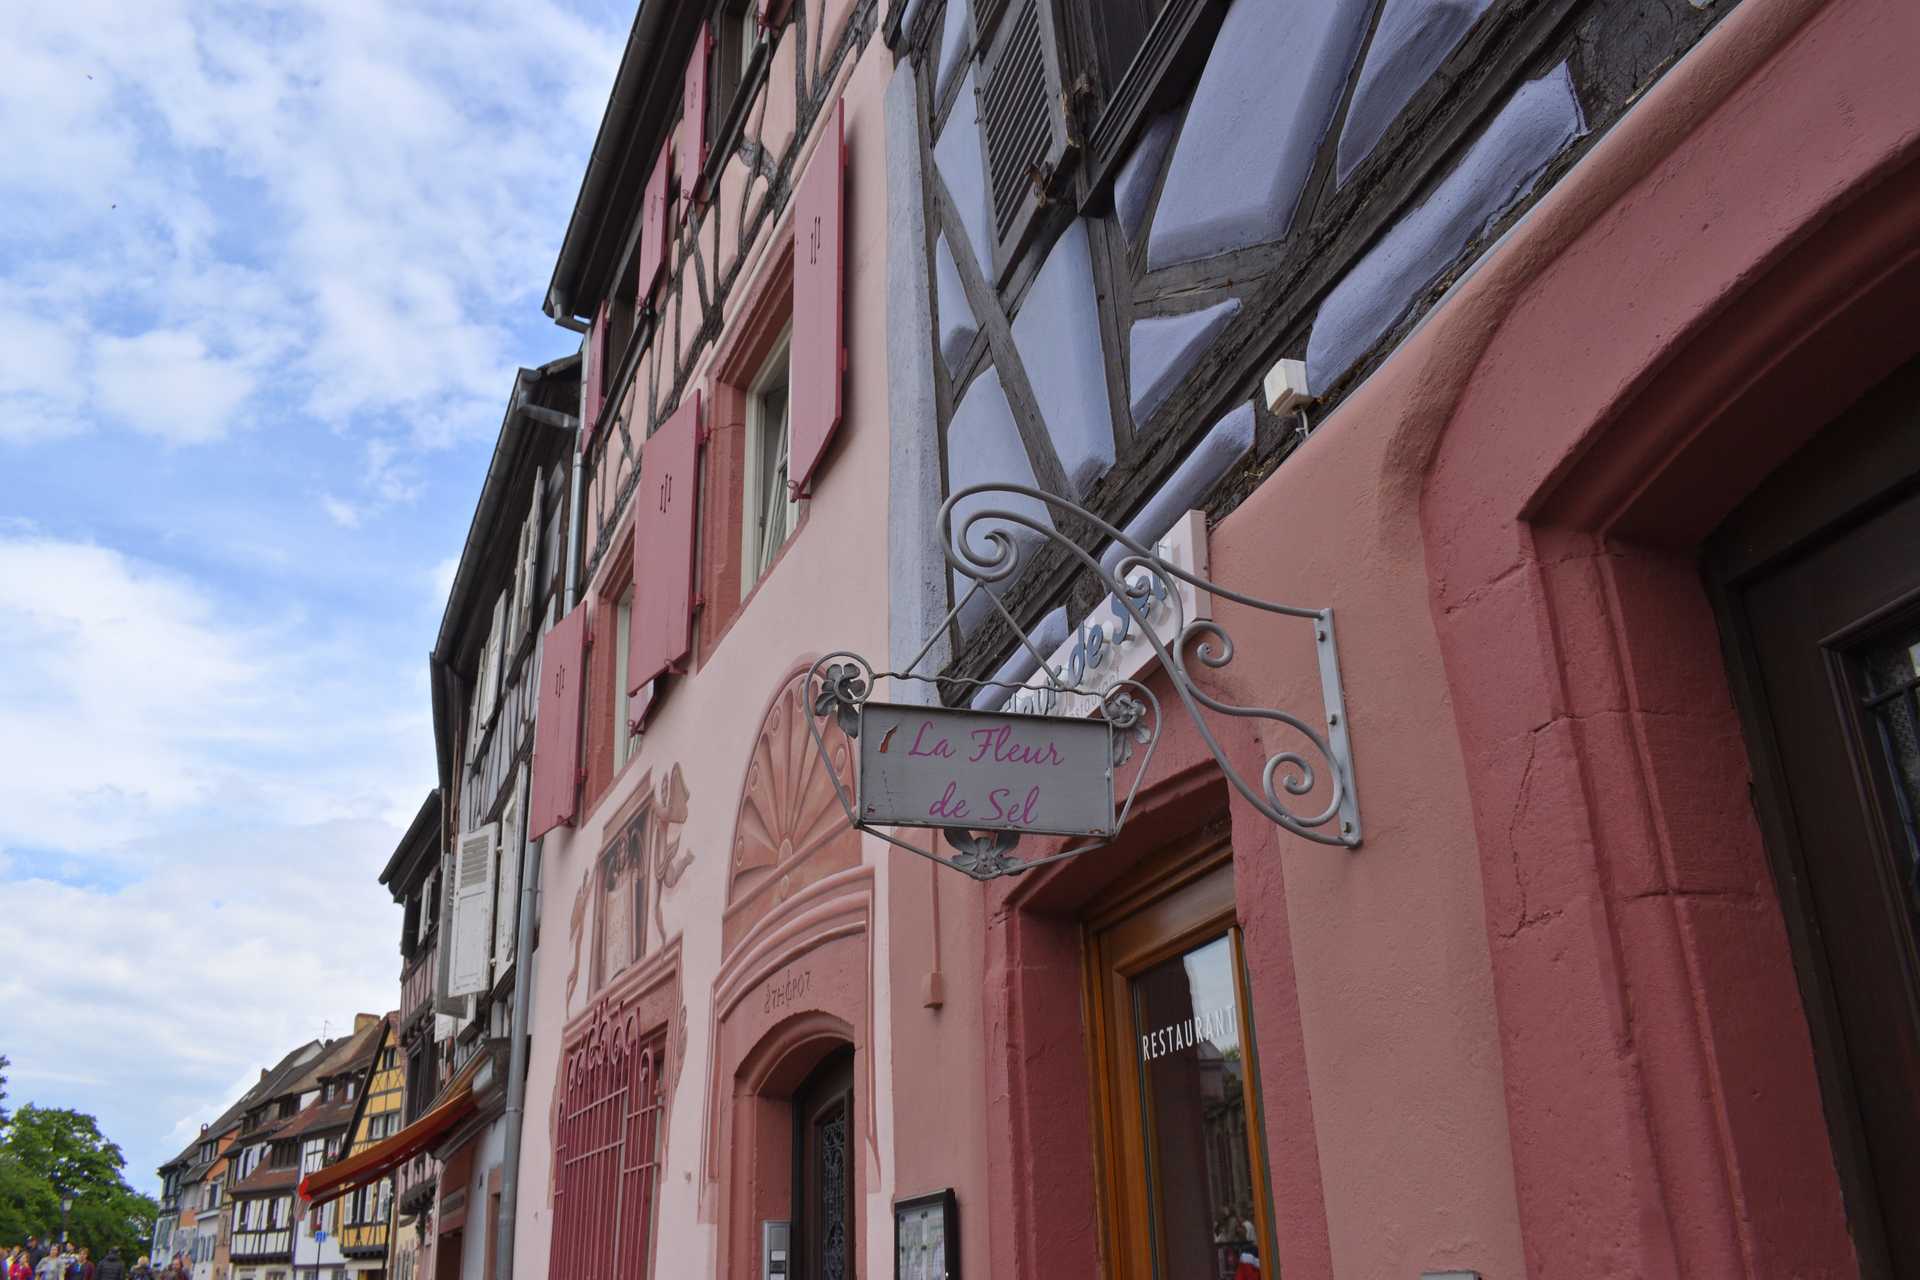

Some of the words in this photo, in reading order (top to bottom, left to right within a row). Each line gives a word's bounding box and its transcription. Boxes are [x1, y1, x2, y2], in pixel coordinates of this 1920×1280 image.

[1068, 620, 1104, 689] de
[907, 719, 956, 759] La
[968, 724, 1065, 766] Fleur
[928, 781, 970, 819] de
[980, 785, 1040, 825] Sel
[1142, 1003, 1236, 1061] RESTAURANT
